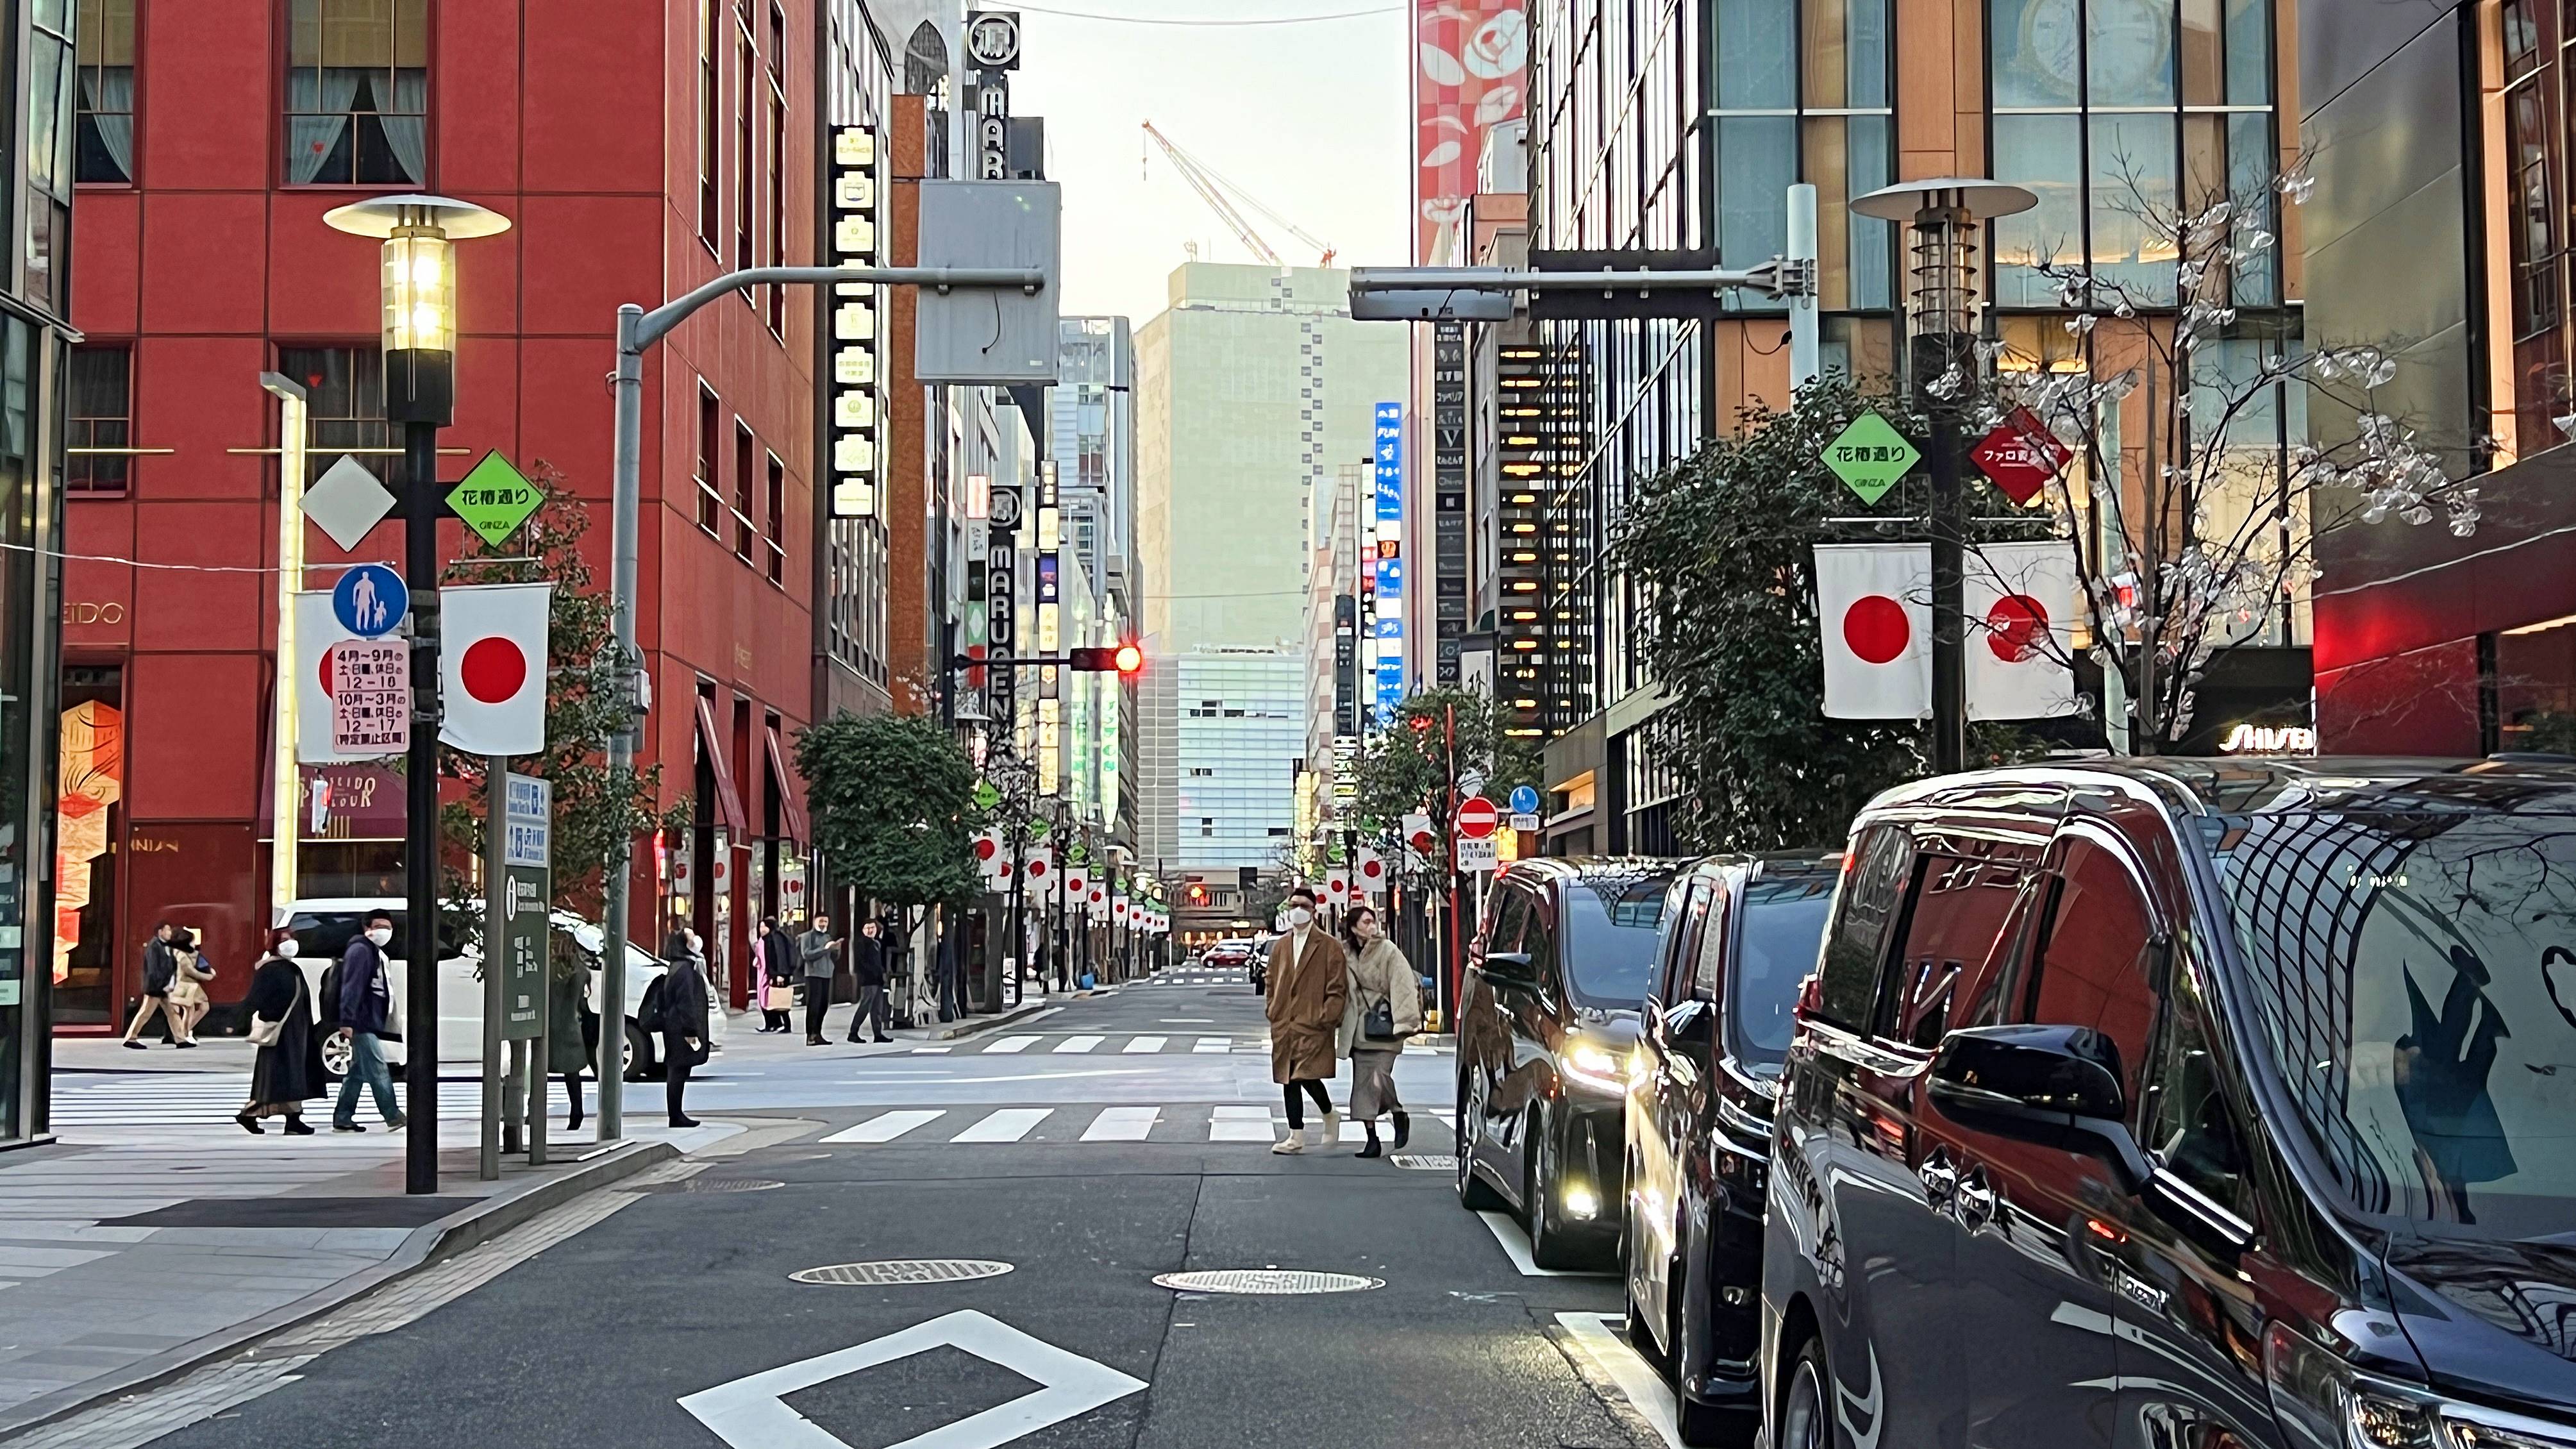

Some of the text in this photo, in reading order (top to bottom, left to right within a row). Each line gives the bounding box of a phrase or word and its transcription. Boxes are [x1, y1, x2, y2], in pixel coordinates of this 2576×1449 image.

[1836, 446, 1905, 462] 花椿通り
[462, 488, 529, 505] 花椿通り
